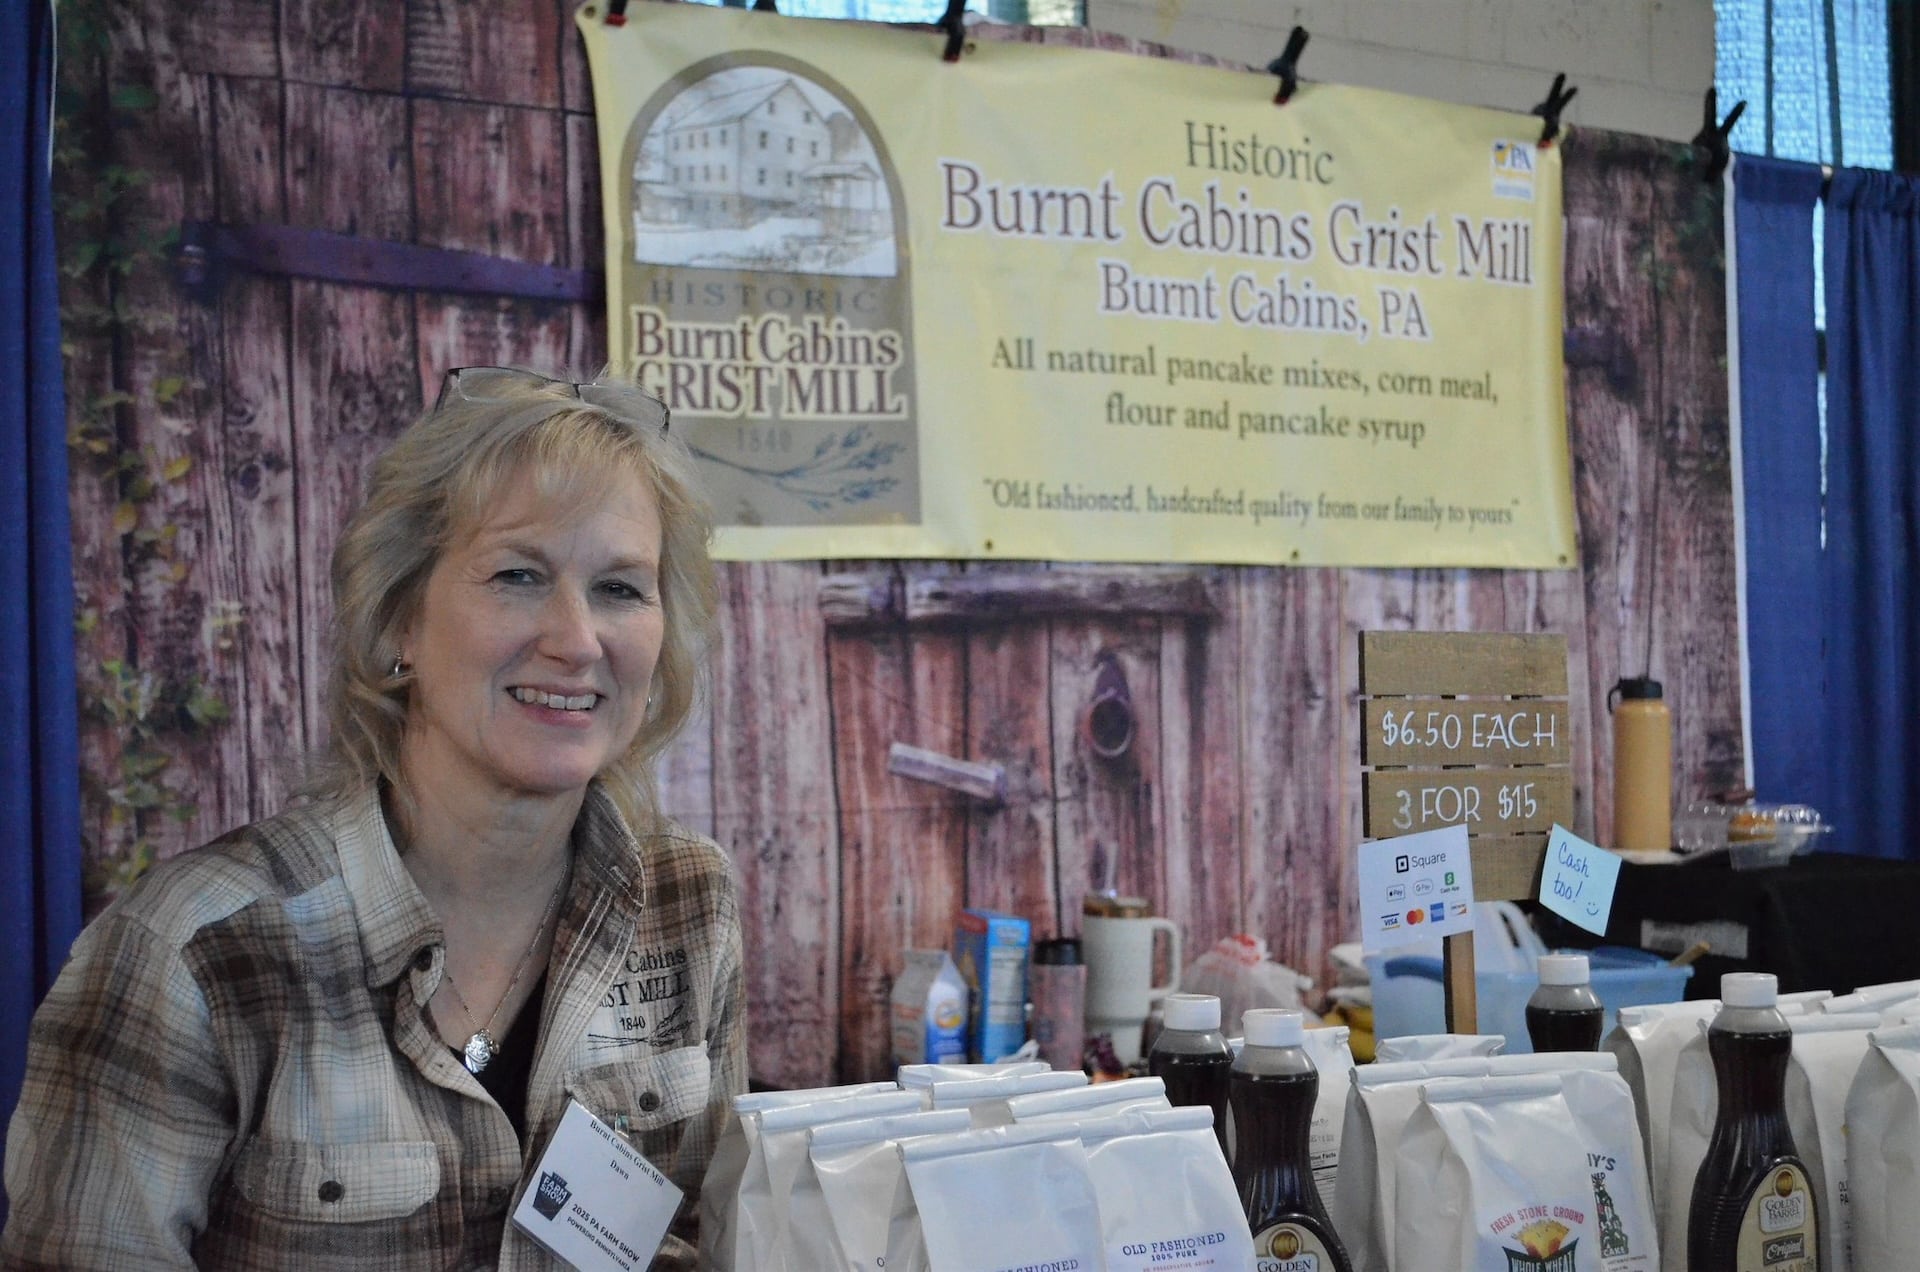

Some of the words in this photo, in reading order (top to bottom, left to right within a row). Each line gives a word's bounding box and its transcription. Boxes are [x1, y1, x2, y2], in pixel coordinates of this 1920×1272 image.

[1185, 120, 1334, 186] Historic
[943, 162, 1122, 240] Burnt
[1141, 180, 1312, 261] Cabins
[1329, 202, 1442, 275] Grist
[1456, 218, 1532, 285] Mill
[650, 278, 881, 315] HISTORIC
[1101, 262, 1217, 320] Burnt
[1230, 274, 1368, 341] Cabins,
[1380, 290, 1429, 339] PA
[635, 310, 753, 362] Burnt
[758, 317, 899, 367] Cabins
[991, 337, 1036, 371] All
[1047, 344, 1157, 377] natural
[1166, 351, 1274, 386] pancake
[1283, 357, 1371, 396] mixes,
[1377, 371, 1433, 396] corn
[1440, 369, 1500, 405] meal,
[637, 360, 774, 414] GRIST
[784, 367, 904, 415] MILL
[1105, 390, 1178, 427] flour
[1184, 400, 1230, 431] and
[1237, 404, 1351, 441] pancake
[1357, 418, 1427, 449] syrup
[736, 426, 794, 454] 1840
[984, 477, 1031, 510] "Old
[1146, 484, 1246, 516] handcrafted
[1249, 490, 1312, 528] quality
[1317, 491, 1358, 520] from
[1361, 502, 1390, 521] our
[1394, 494, 1444, 533] family
[1448, 504, 1465, 523] to
[1382, 709, 1463, 749] $6.50
[1471, 711, 1556, 750] EACH
[1393, 789, 1413, 830] 3
[1421, 785, 1482, 824] FOR
[1498, 782, 1538, 821] $15
[1411, 852, 1447, 869] Square
[1557, 841, 1590, 879] Cash
[1553, 874, 1583, 904] too!
[1384, 917, 1399, 927] VISA
[625, 946, 688, 974] Cabins
[637, 971, 691, 1004] MILL
[619, 1015, 646, 1032] 1840
[589, 1119, 612, 1142] Burnt
[610, 1136, 634, 1161] Cabins
[633, 1157, 651, 1176] Grist
[651, 1170, 665, 1187] Mill
[609, 1159, 631, 1181] Dawn
[540, 1183, 565, 1205] SHOW
[543, 1175, 569, 1200] FARM
[1765, 1196, 1801, 1211] GOLDEN
[1768, 1207, 1801, 1219] BARREL
[566, 1215, 596, 1242] POWERING
[571, 1203, 591, 1223] 2025
[590, 1216, 601, 1230] PA
[599, 1226, 620, 1248] FARM
[619, 1242, 640, 1263] SHOW
[1490, 1213, 1516, 1235] FRESH
[1517, 1205, 1549, 1221] STONE
[1553, 1206, 1585, 1225] GROUND
[1122, 1243, 1147, 1256] OLD
[1151, 1232, 1226, 1253] FASHIONED
[1151, 1252, 1173, 1262] 100%
[1175, 1249, 1198, 1259] PURE
[1766, 1237, 1803, 1259] Original
[1257, 1259, 1312, 1272] GOLDEN
